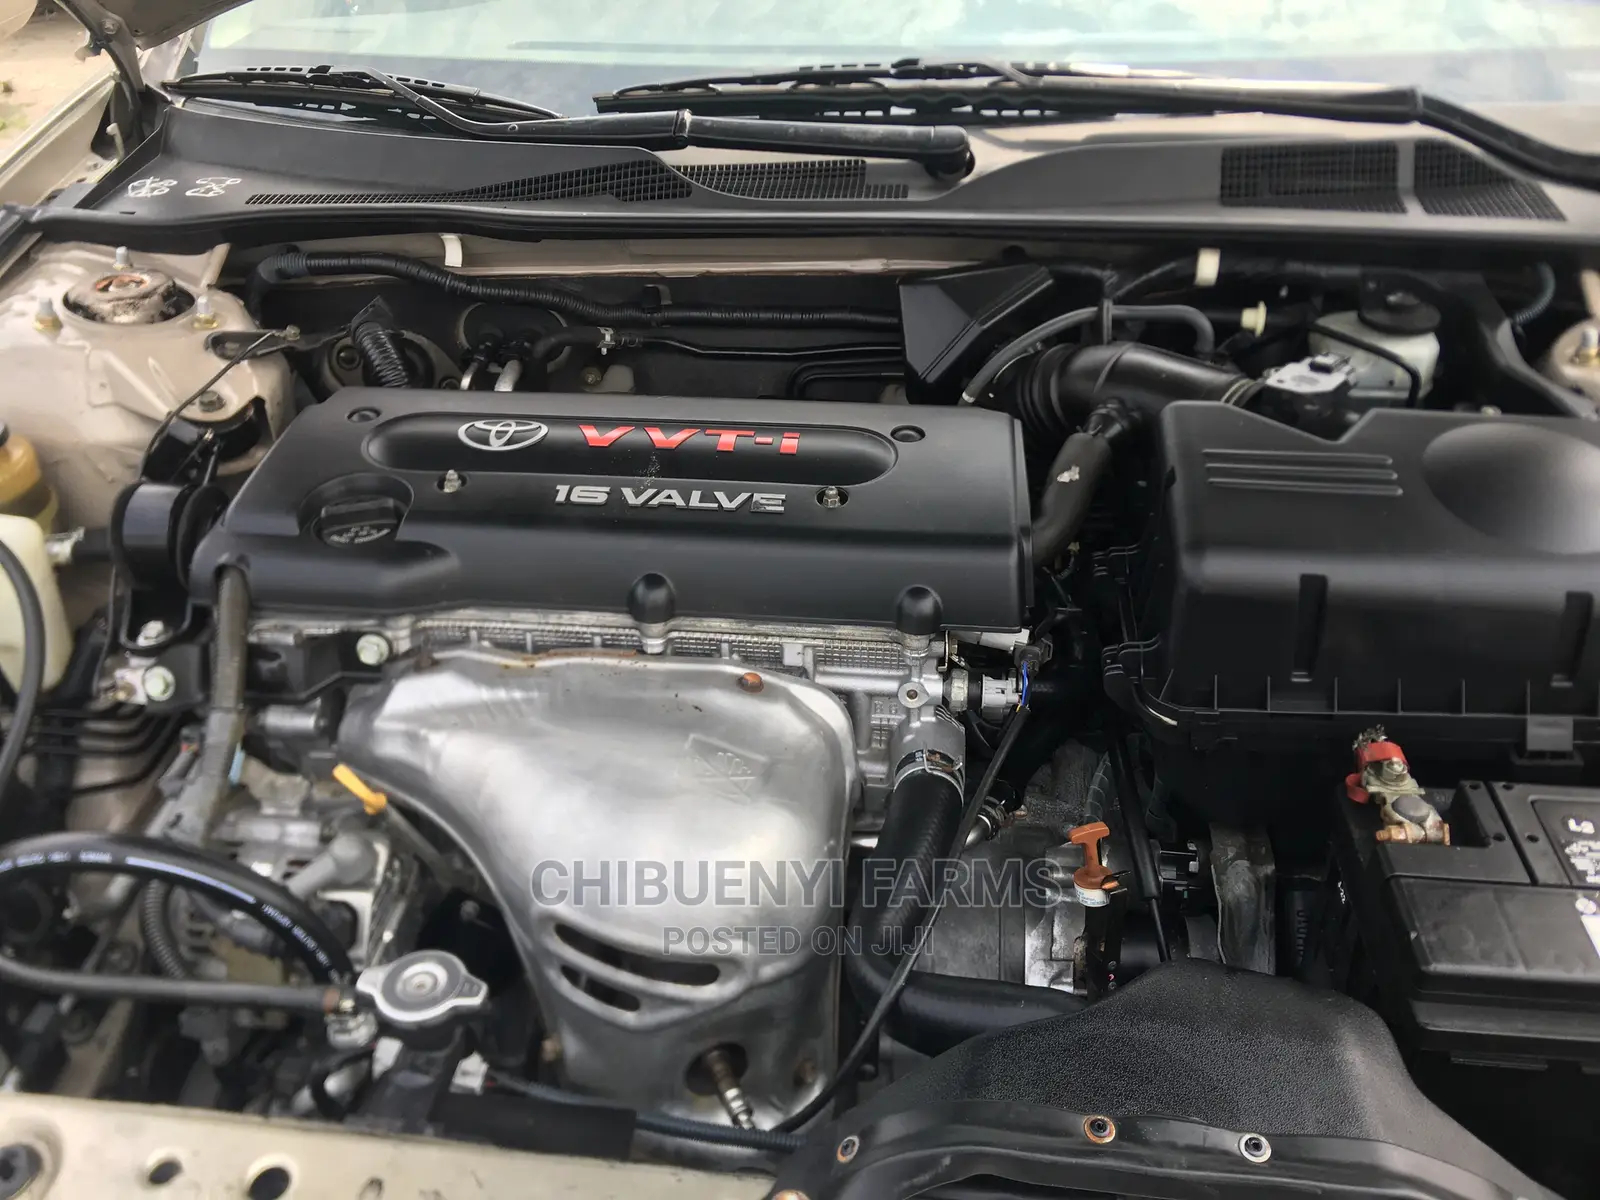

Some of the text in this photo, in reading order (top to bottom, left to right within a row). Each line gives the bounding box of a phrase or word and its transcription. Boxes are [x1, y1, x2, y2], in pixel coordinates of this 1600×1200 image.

[578, 424, 801, 455] VVT-i
[554, 484, 787, 514] 16 VALVE
